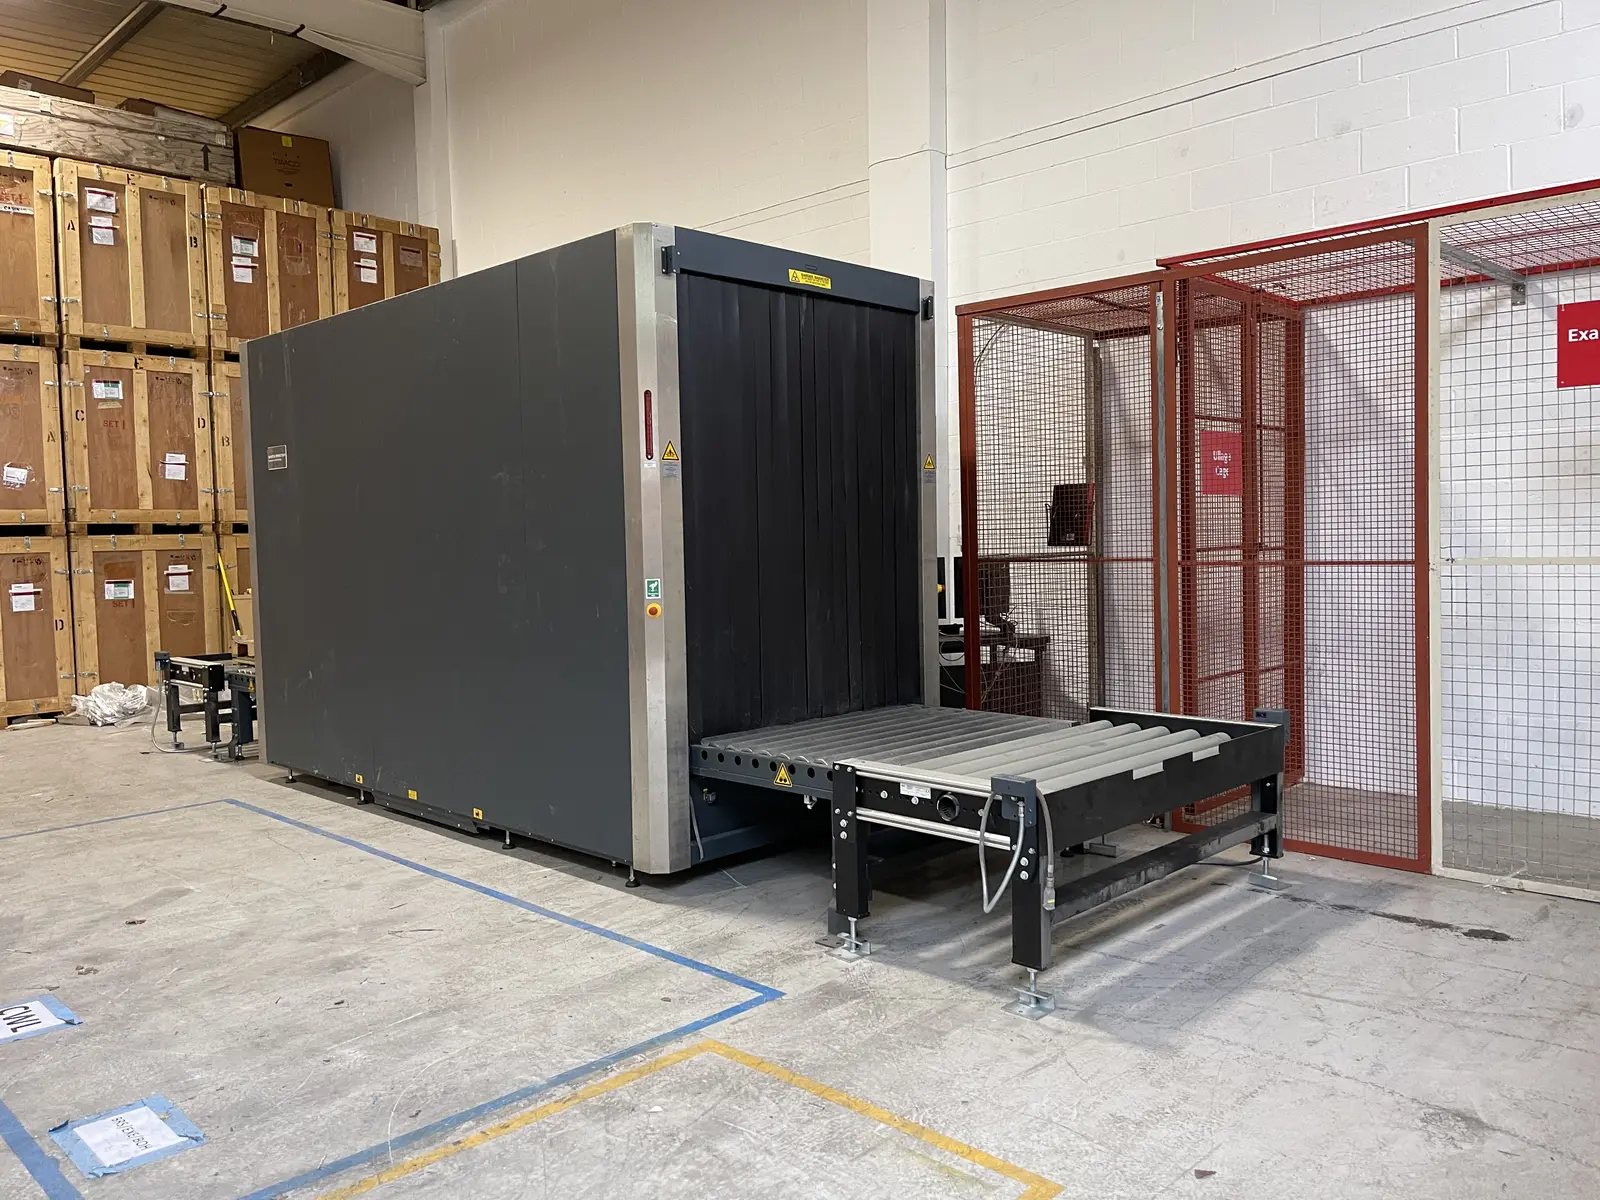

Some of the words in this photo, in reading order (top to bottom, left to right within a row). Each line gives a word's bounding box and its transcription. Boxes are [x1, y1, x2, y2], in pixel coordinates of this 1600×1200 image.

[67, 219, 76, 231] A
[189, 236, 198, 248] B
[1568, 328, 1599, 342] Exa
[134, 357, 143, 369] E
[75, 409, 85, 422] C
[103, 419, 119, 428] SET
[197, 417, 206, 429] D
[47, 432, 56, 443] A
[221, 436, 230, 446] B
[55, 619, 64, 631] D
[0, 1005, 42, 1033] CWL
